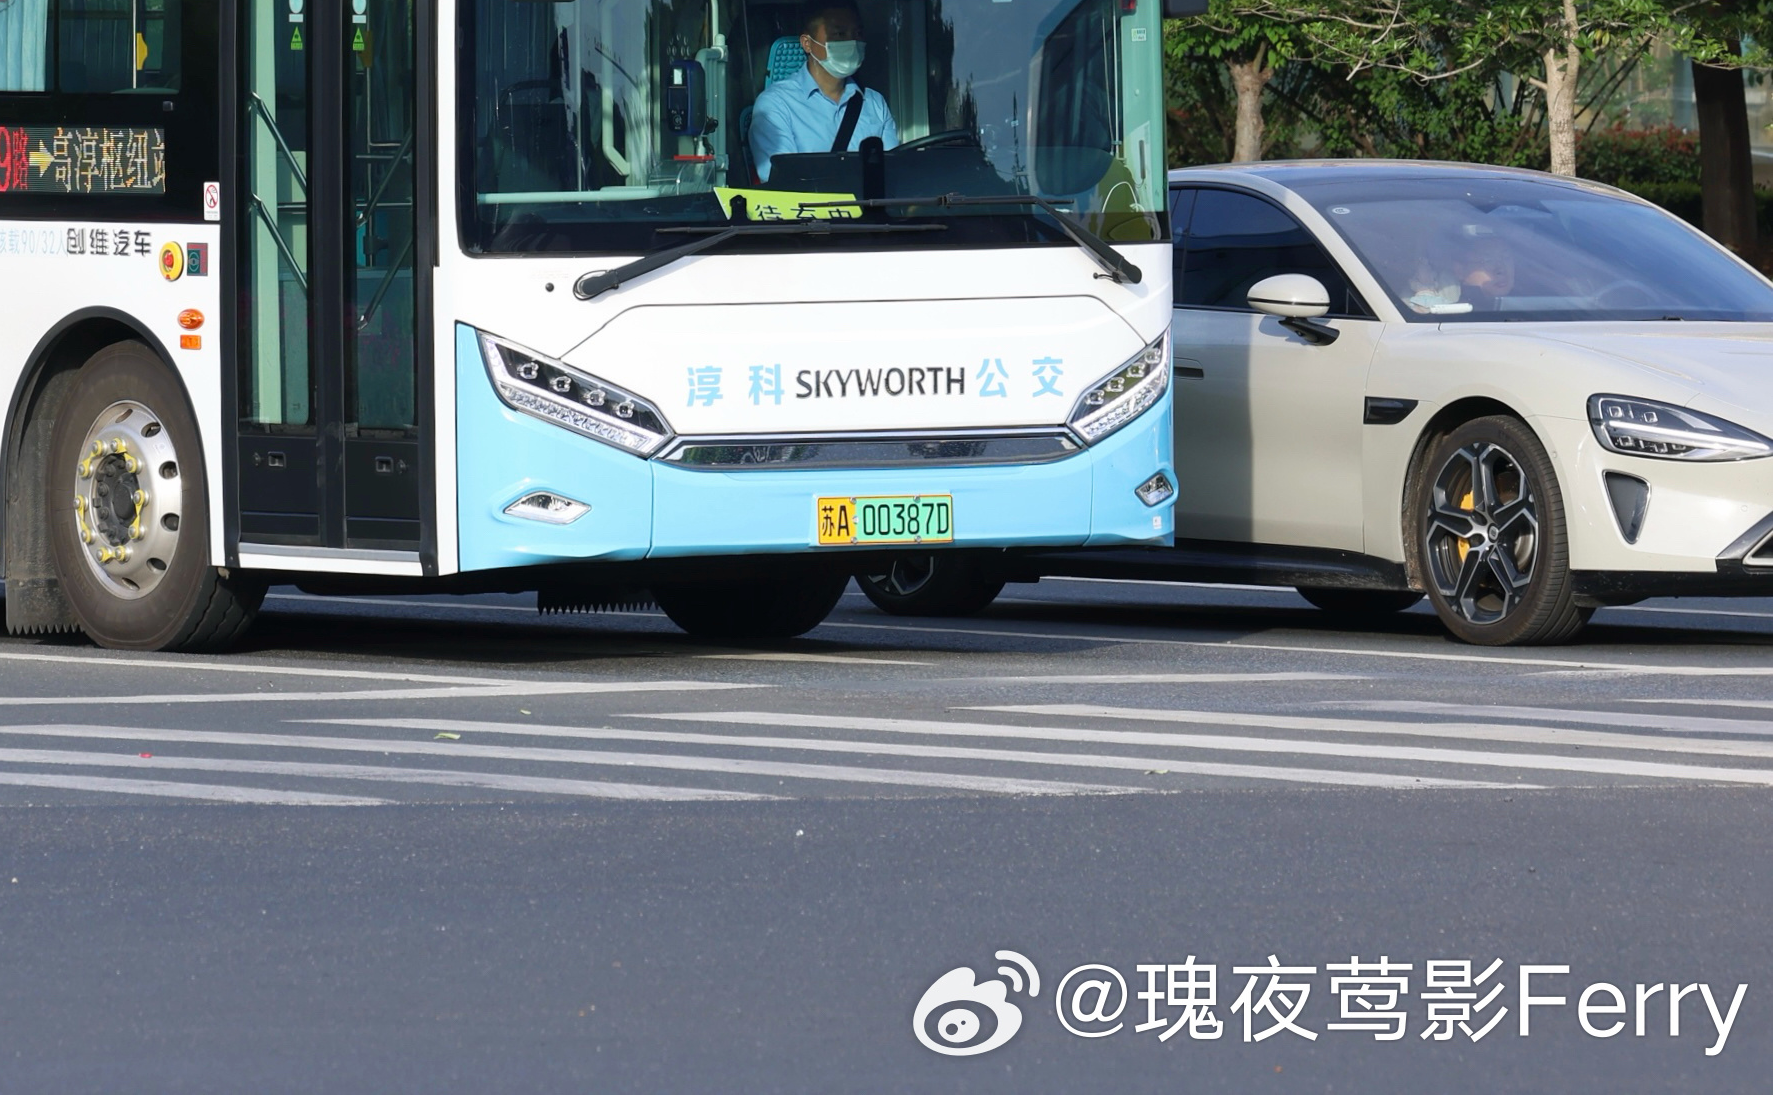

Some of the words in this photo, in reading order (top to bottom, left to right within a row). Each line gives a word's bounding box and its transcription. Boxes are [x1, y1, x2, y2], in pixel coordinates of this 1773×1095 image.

[66, 227, 152, 256] 创维汽车
[687, 364, 784, 407] 淳科
[795, 367, 965, 398] SKYWORTH
[975, 356, 1064, 398] 公交
